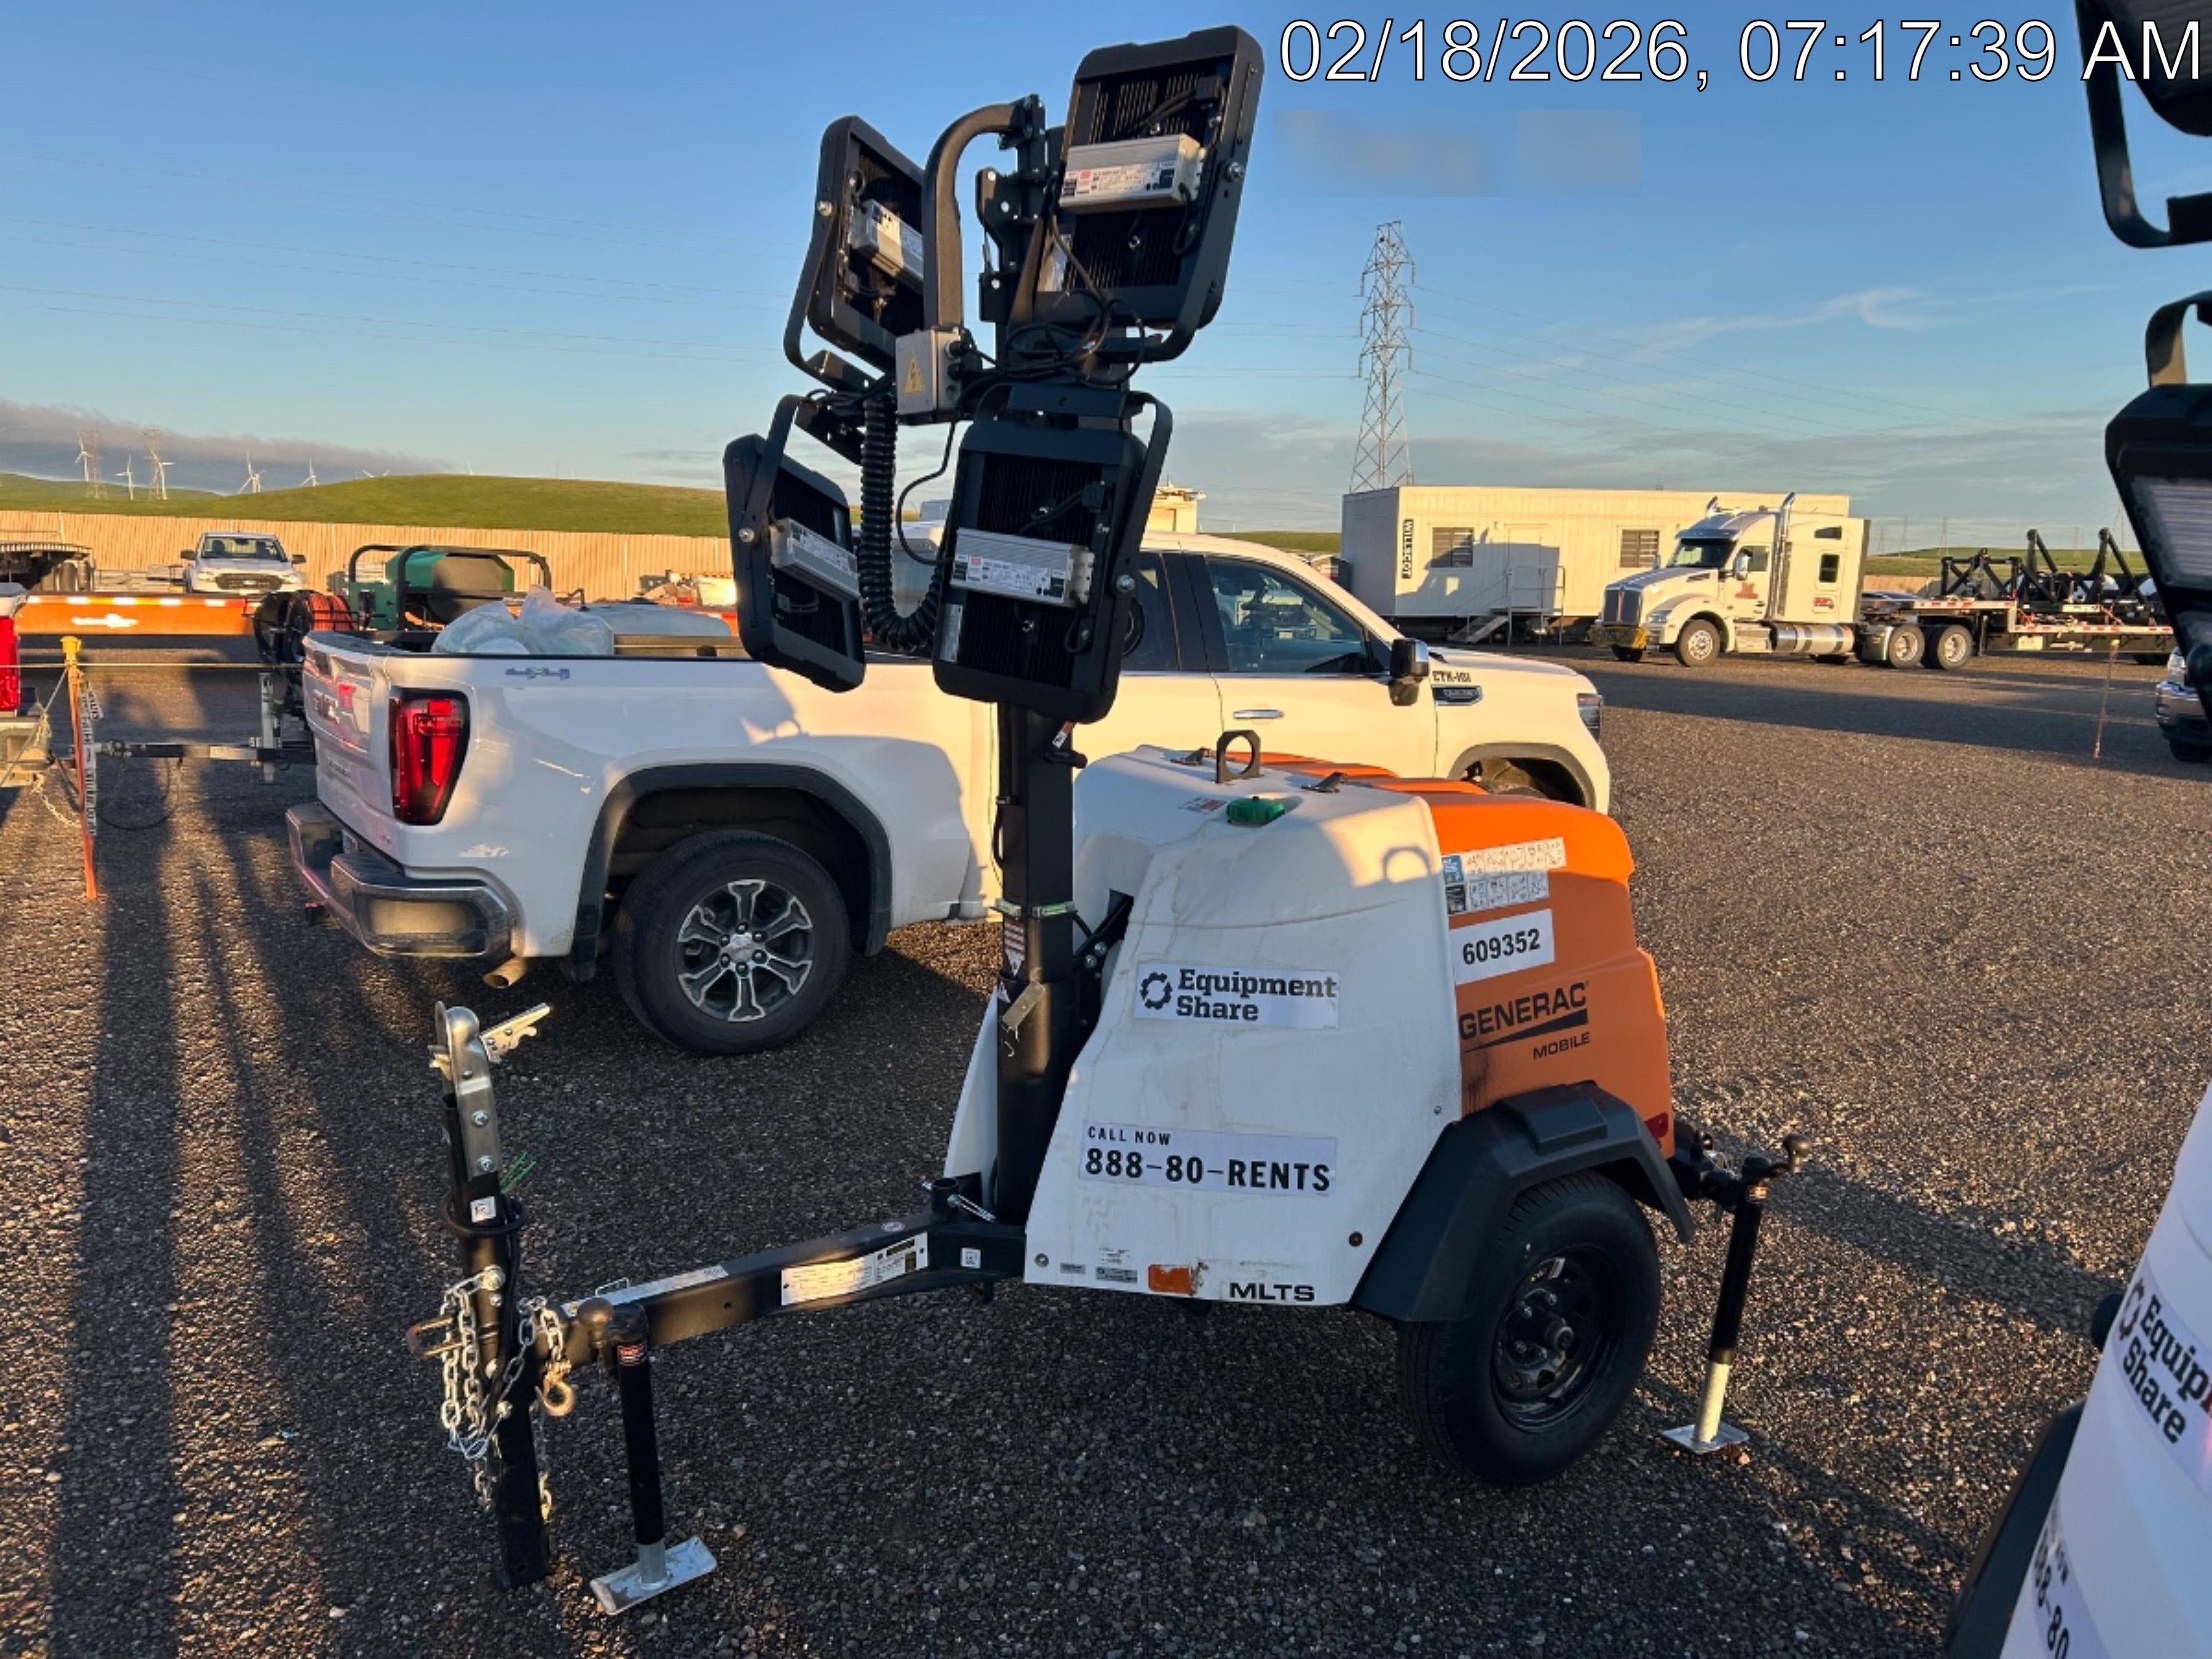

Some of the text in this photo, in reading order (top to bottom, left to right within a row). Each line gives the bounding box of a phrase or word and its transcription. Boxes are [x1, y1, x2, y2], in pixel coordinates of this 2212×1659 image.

[1462, 928, 1541, 965] 609352
[1177, 968, 1337, 998] Equipment
[1175, 995, 1259, 1021] Share
[1459, 982, 1588, 1041] GENERAC
[1532, 1031, 1591, 1061] MOBILE
[1088, 1126, 1171, 1146] CALL NOW
[1230, 1282, 1316, 1302] MLTS
[2123, 1335, 2186, 1445] Share
